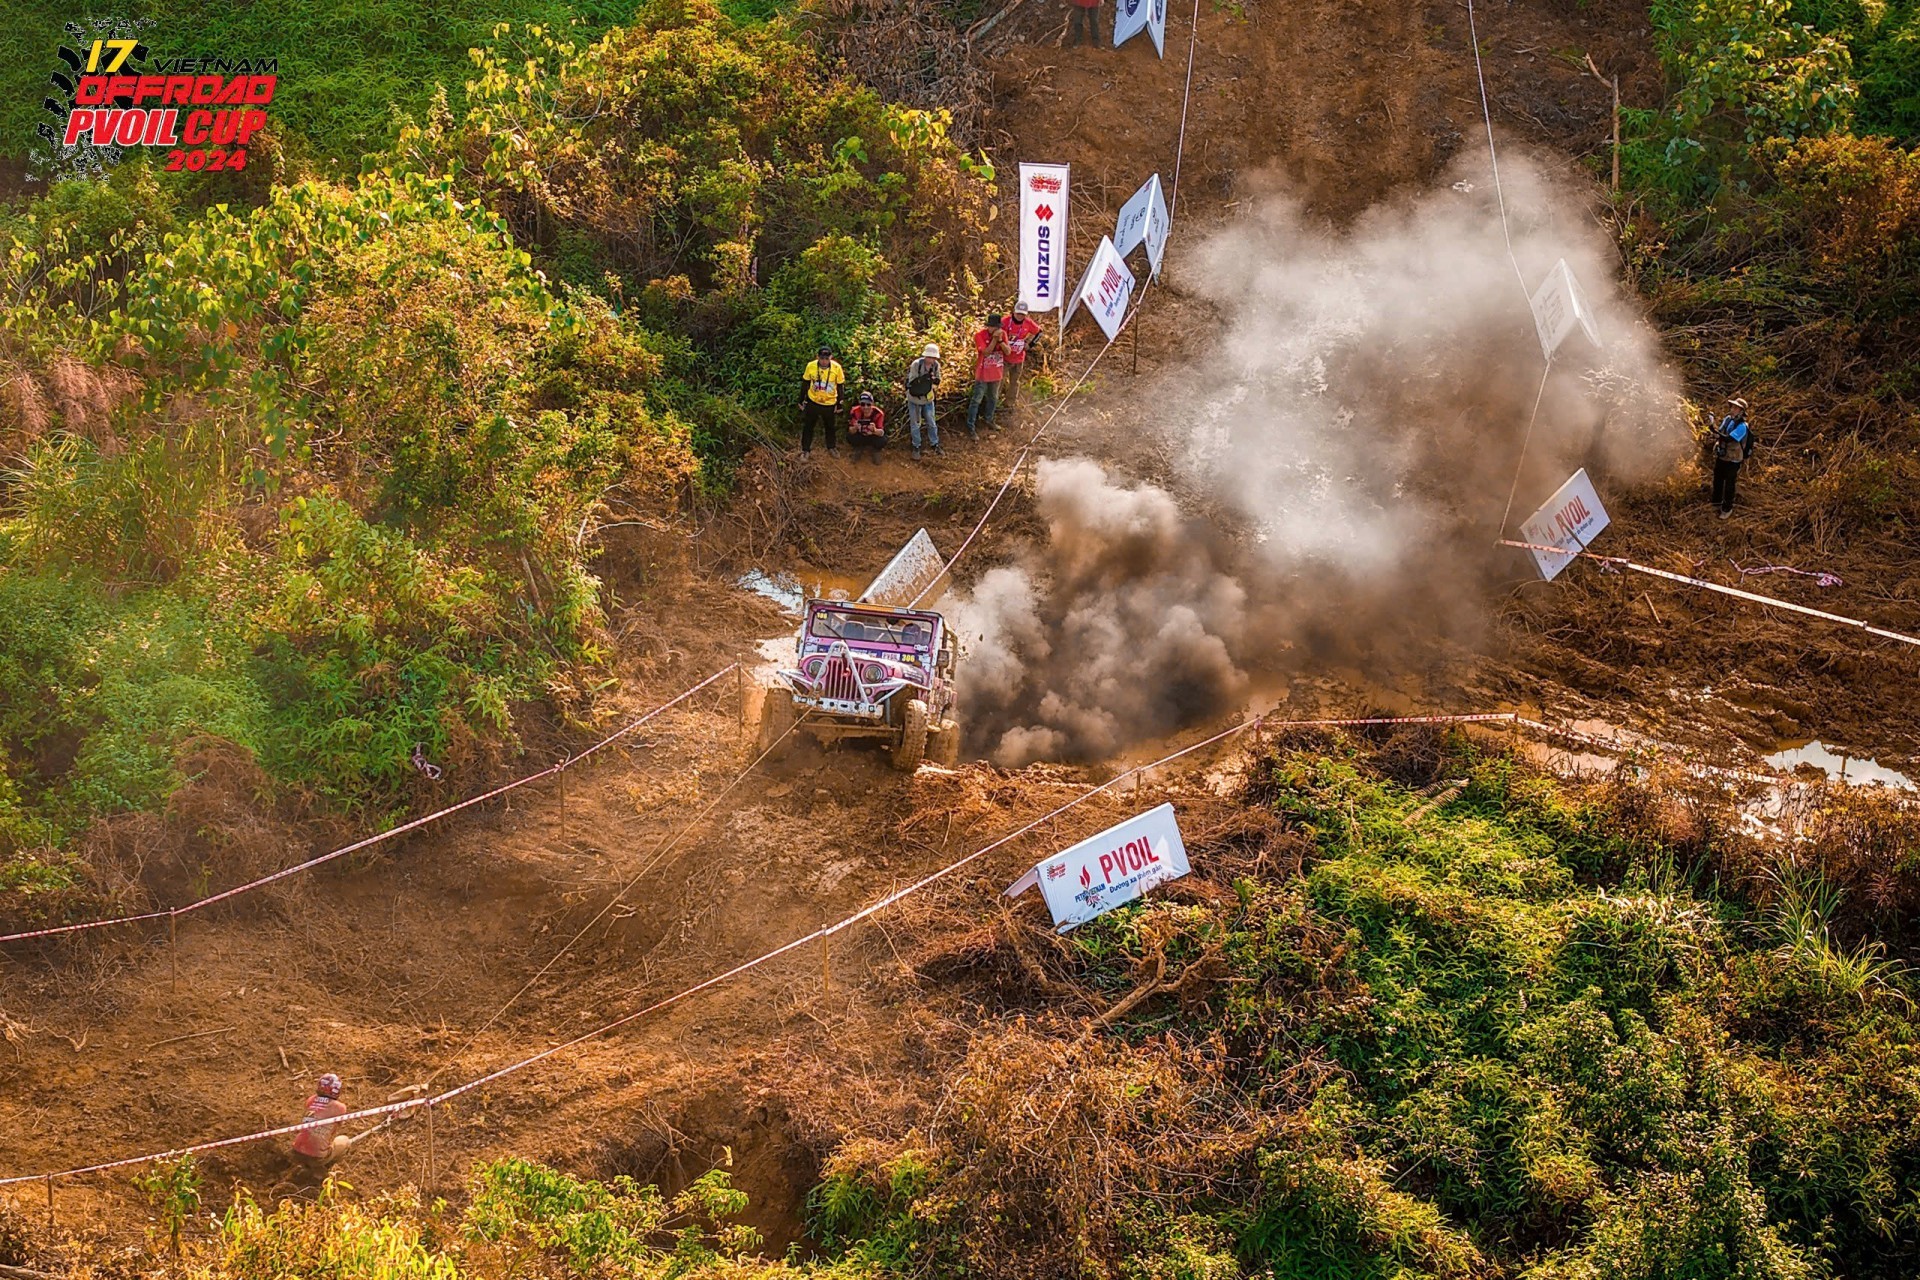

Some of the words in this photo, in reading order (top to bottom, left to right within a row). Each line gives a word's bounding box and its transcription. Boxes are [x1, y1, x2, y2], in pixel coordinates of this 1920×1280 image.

[1037, 225, 1051, 298] SUZUKI
[1101, 262, 1122, 301] PVOIL
[1554, 494, 1591, 537] PVOIL
[1098, 835, 1160, 884] PVOIL
[1109, 880, 1130, 893] Đường
